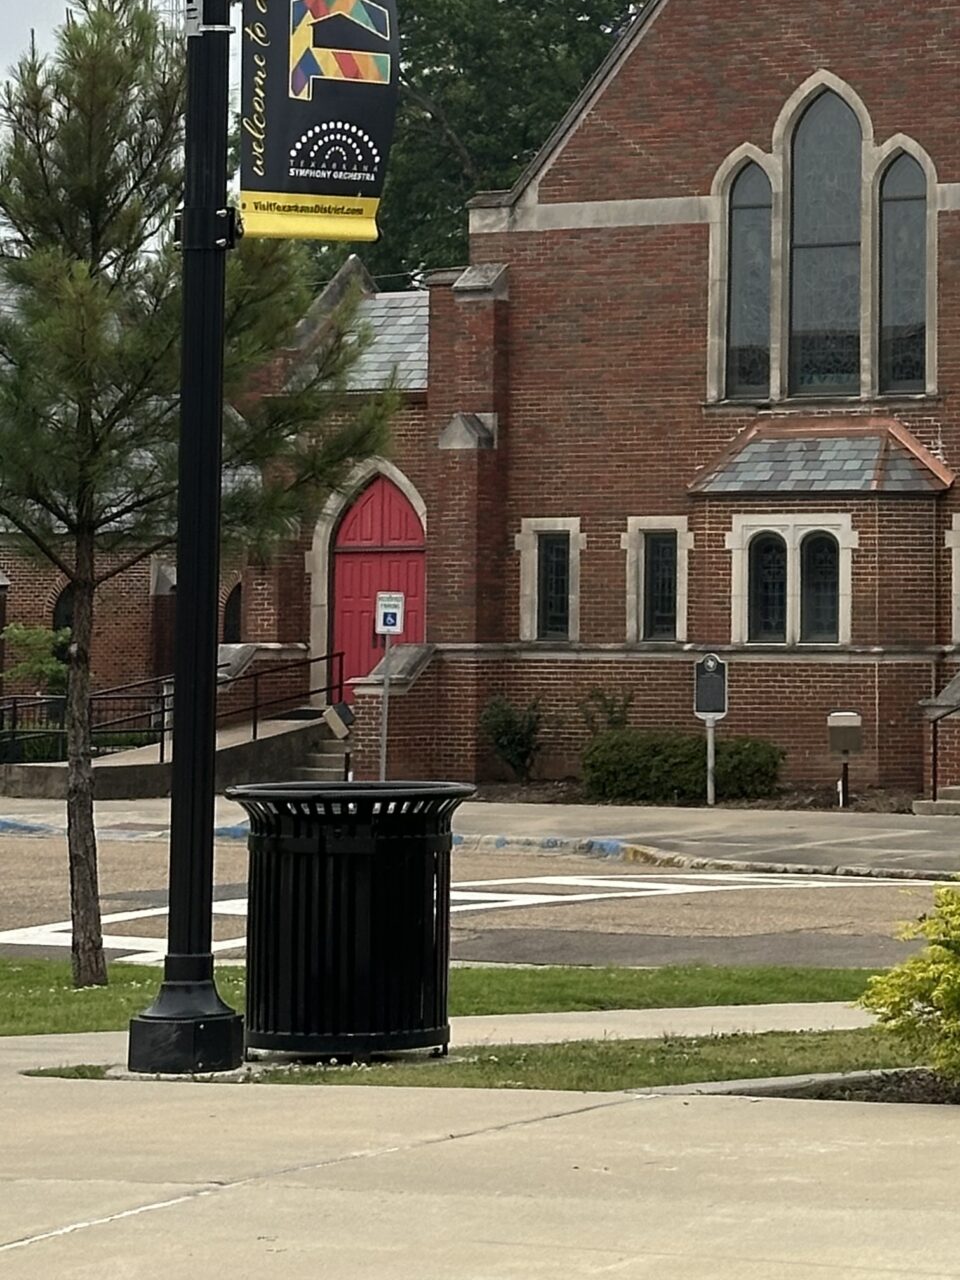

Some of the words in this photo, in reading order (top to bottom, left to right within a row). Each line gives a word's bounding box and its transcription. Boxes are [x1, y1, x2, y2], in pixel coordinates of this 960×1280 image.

[244, 22, 271, 47] to
[242, 54, 268, 177] welcome
[289, 167, 333, 180] SYMPHONY
[332, 169, 376, 182] ORCHESTRA
